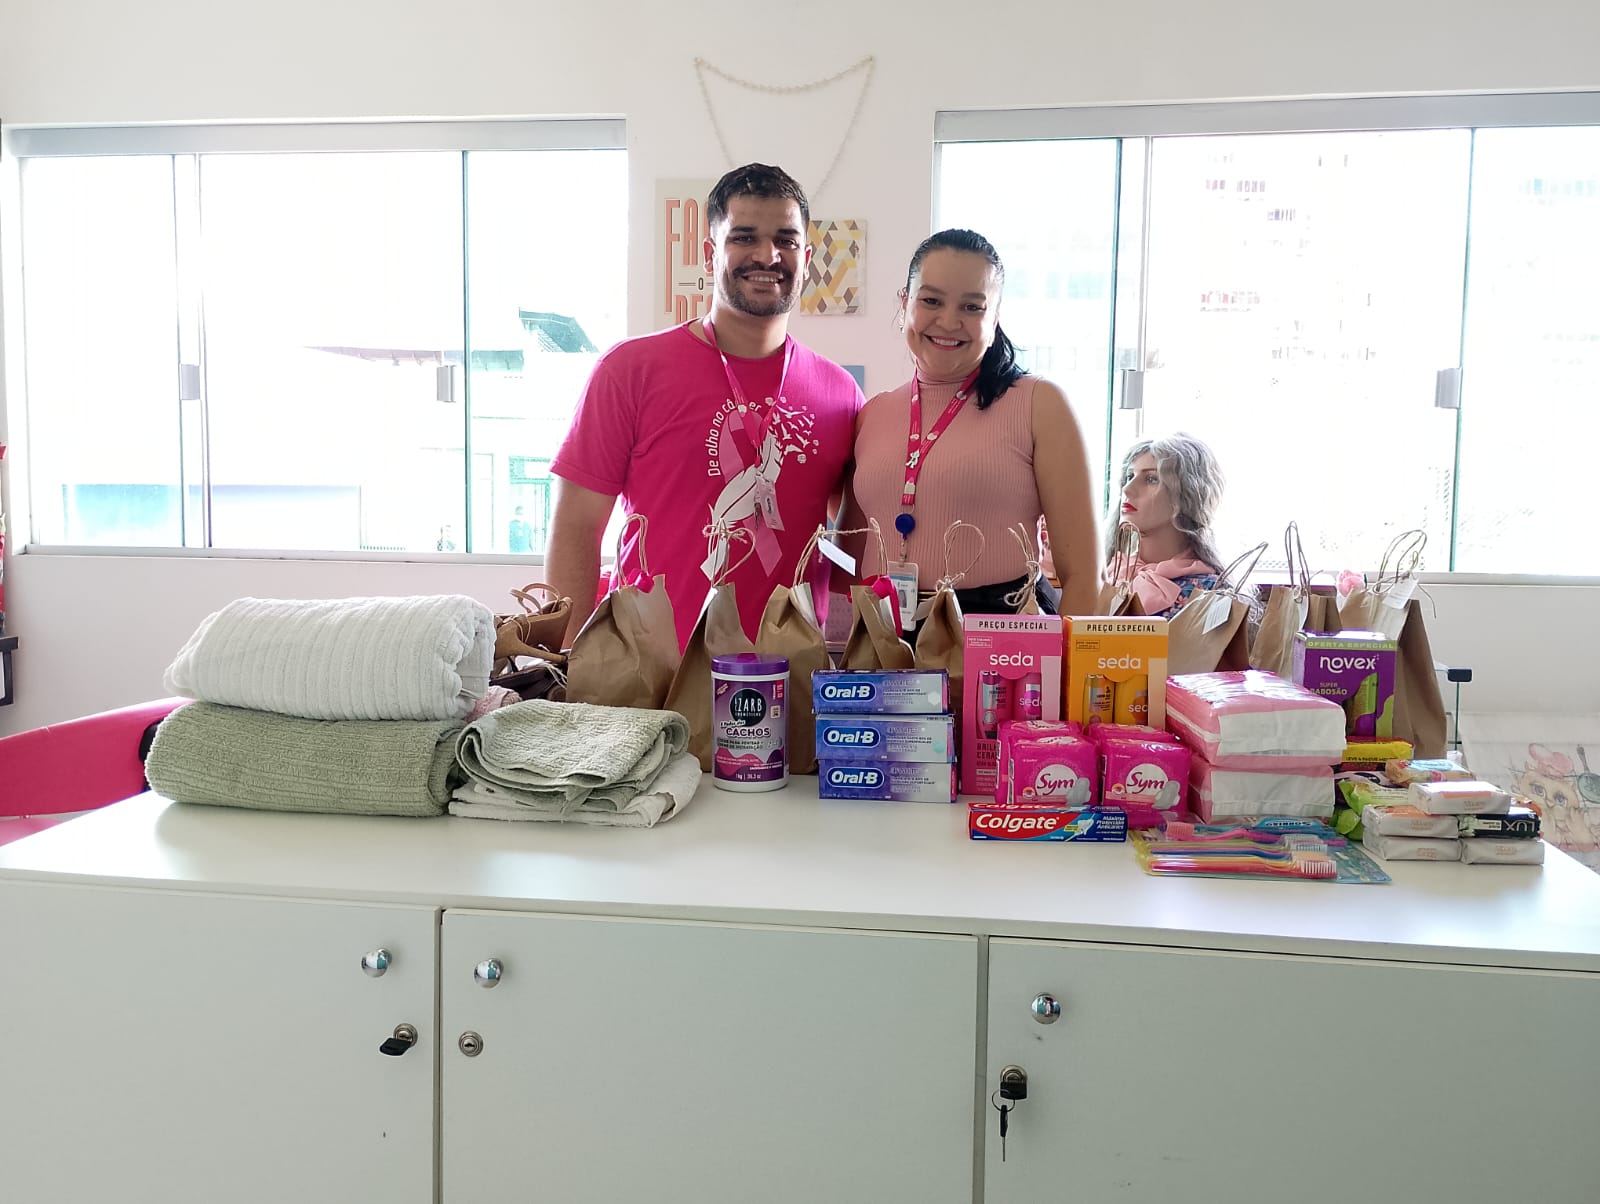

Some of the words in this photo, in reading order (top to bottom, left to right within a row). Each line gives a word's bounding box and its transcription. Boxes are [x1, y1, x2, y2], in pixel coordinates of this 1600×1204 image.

[698, 277, 705, 291] O
[721, 398, 762, 414] câer
[712, 412, 725, 428] no
[704, 429, 719, 457] olho
[707, 461, 721, 477] De
[979, 620, 1005, 630] PREÇO
[1008, 621, 1048, 630] ESPECIAL
[1086, 624, 1113, 633] PREÇO
[1116, 623, 1156, 633] ESPECIAL
[989, 651, 1034, 667] seda
[1097, 653, 1142, 670] seda
[1319, 655, 1376, 674] novex
[824, 685, 871, 698] Oral-B
[1019, 697, 1042, 707] sed
[726, 727, 771, 737] CACHOS
[827, 730, 874, 744] Oral-B
[831, 771, 878, 785] Oral-B
[1036, 773, 1075, 796] Sym
[1126, 771, 1165, 795] Sym
[976, 813, 1057, 833] Colgate
[1503, 820, 1536, 832] LUX
